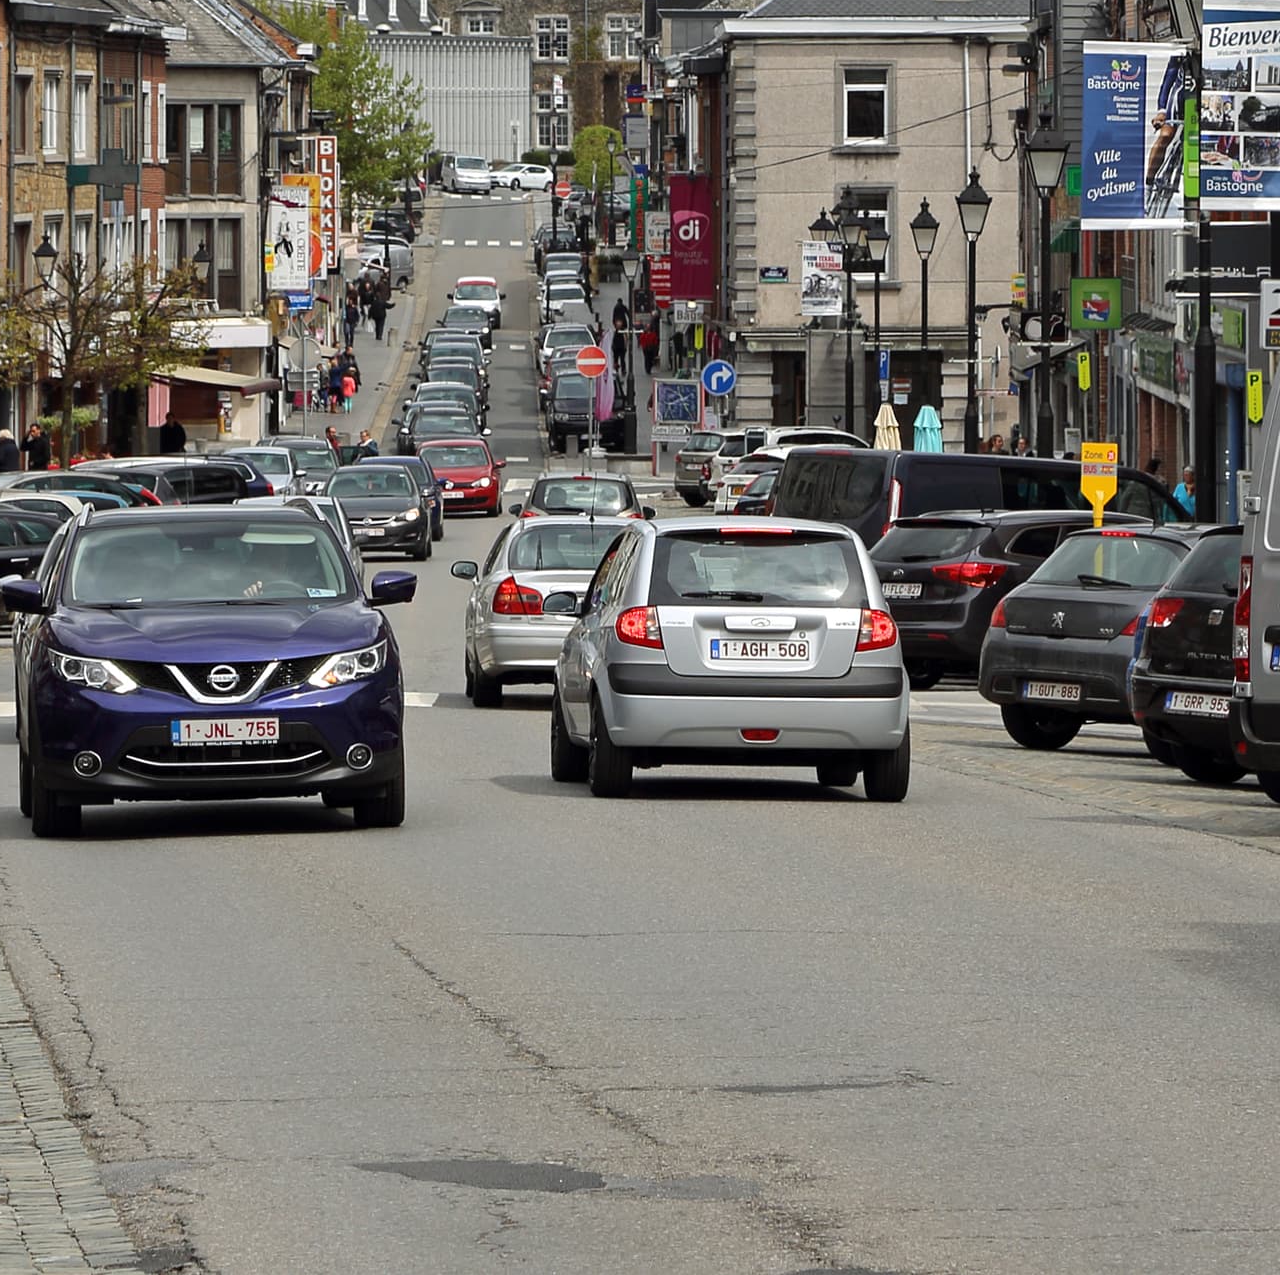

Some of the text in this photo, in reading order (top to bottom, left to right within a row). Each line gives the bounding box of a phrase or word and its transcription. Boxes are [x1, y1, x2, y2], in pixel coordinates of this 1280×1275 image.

[1087, 78, 1141, 93] Bastogne
[1094, 149, 1121, 165] Ville
[1101, 166, 1118, 180] du
[1086, 180, 1136, 201] cyclisme
[1206, 179, 1263, 194] Bastogne
[320, 139, 334, 266] BLOKKER
[678, 219, 700, 241] di
[676, 309, 703, 322] Bags
[880, 351, 887, 369] P
[1080, 355, 1087, 364] P
[1250, 374, 1259, 386] P
[1084, 450, 1103, 460] Zone
[1083, 465, 1098, 474] BUS
[722, 642, 807, 658] 1-AGH-508
[1029, 684, 1080, 699] 1-GUT-883
[184, 721, 277, 739] 1-JNL-755
